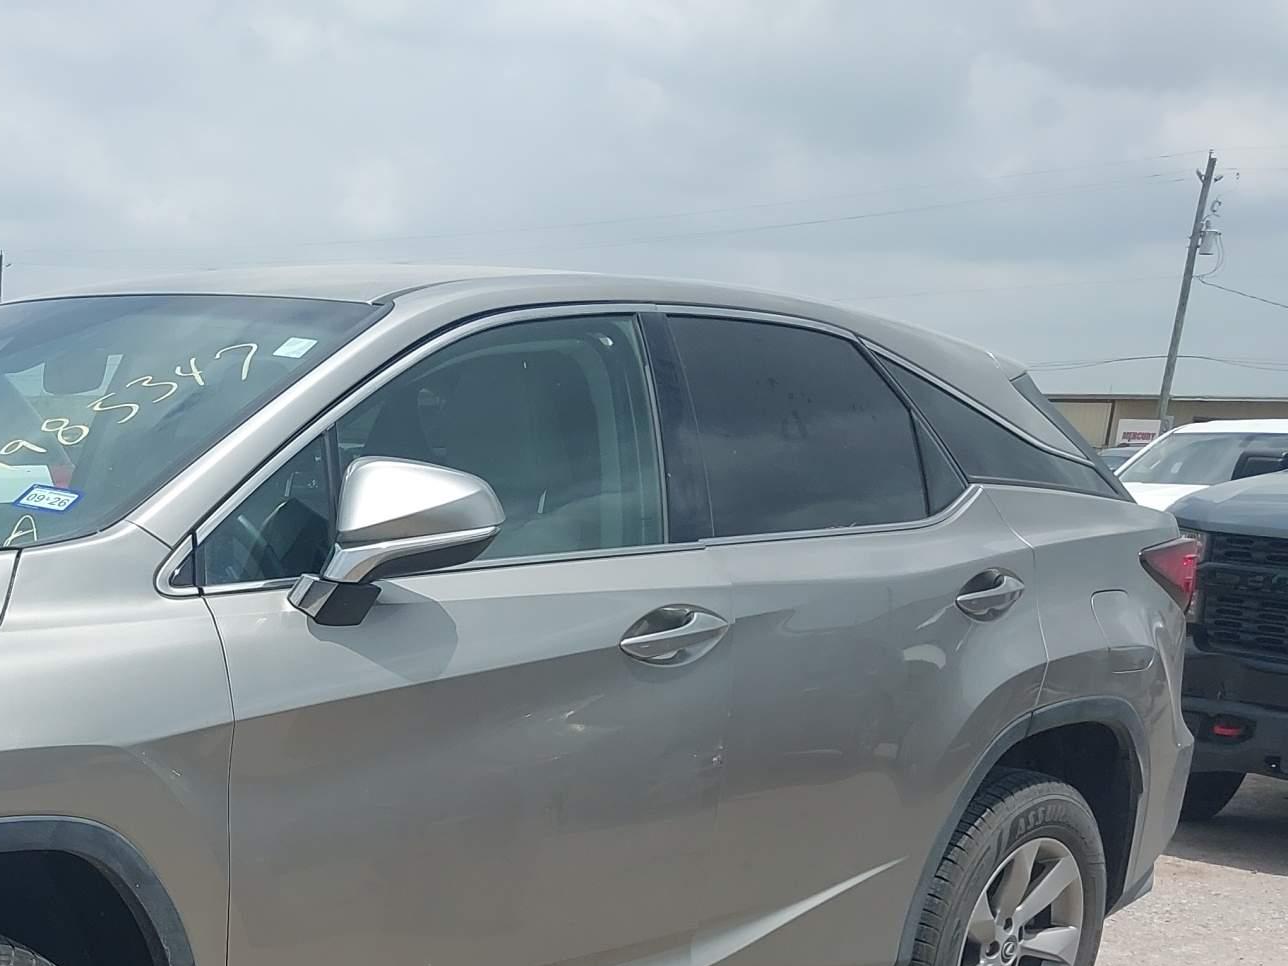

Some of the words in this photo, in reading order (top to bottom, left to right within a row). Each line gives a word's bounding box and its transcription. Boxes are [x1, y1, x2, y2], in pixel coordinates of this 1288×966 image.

[26, 493, 45, 503] 09
[48, 496, 70, 508] 26
[2, 514, 38, 547] A
